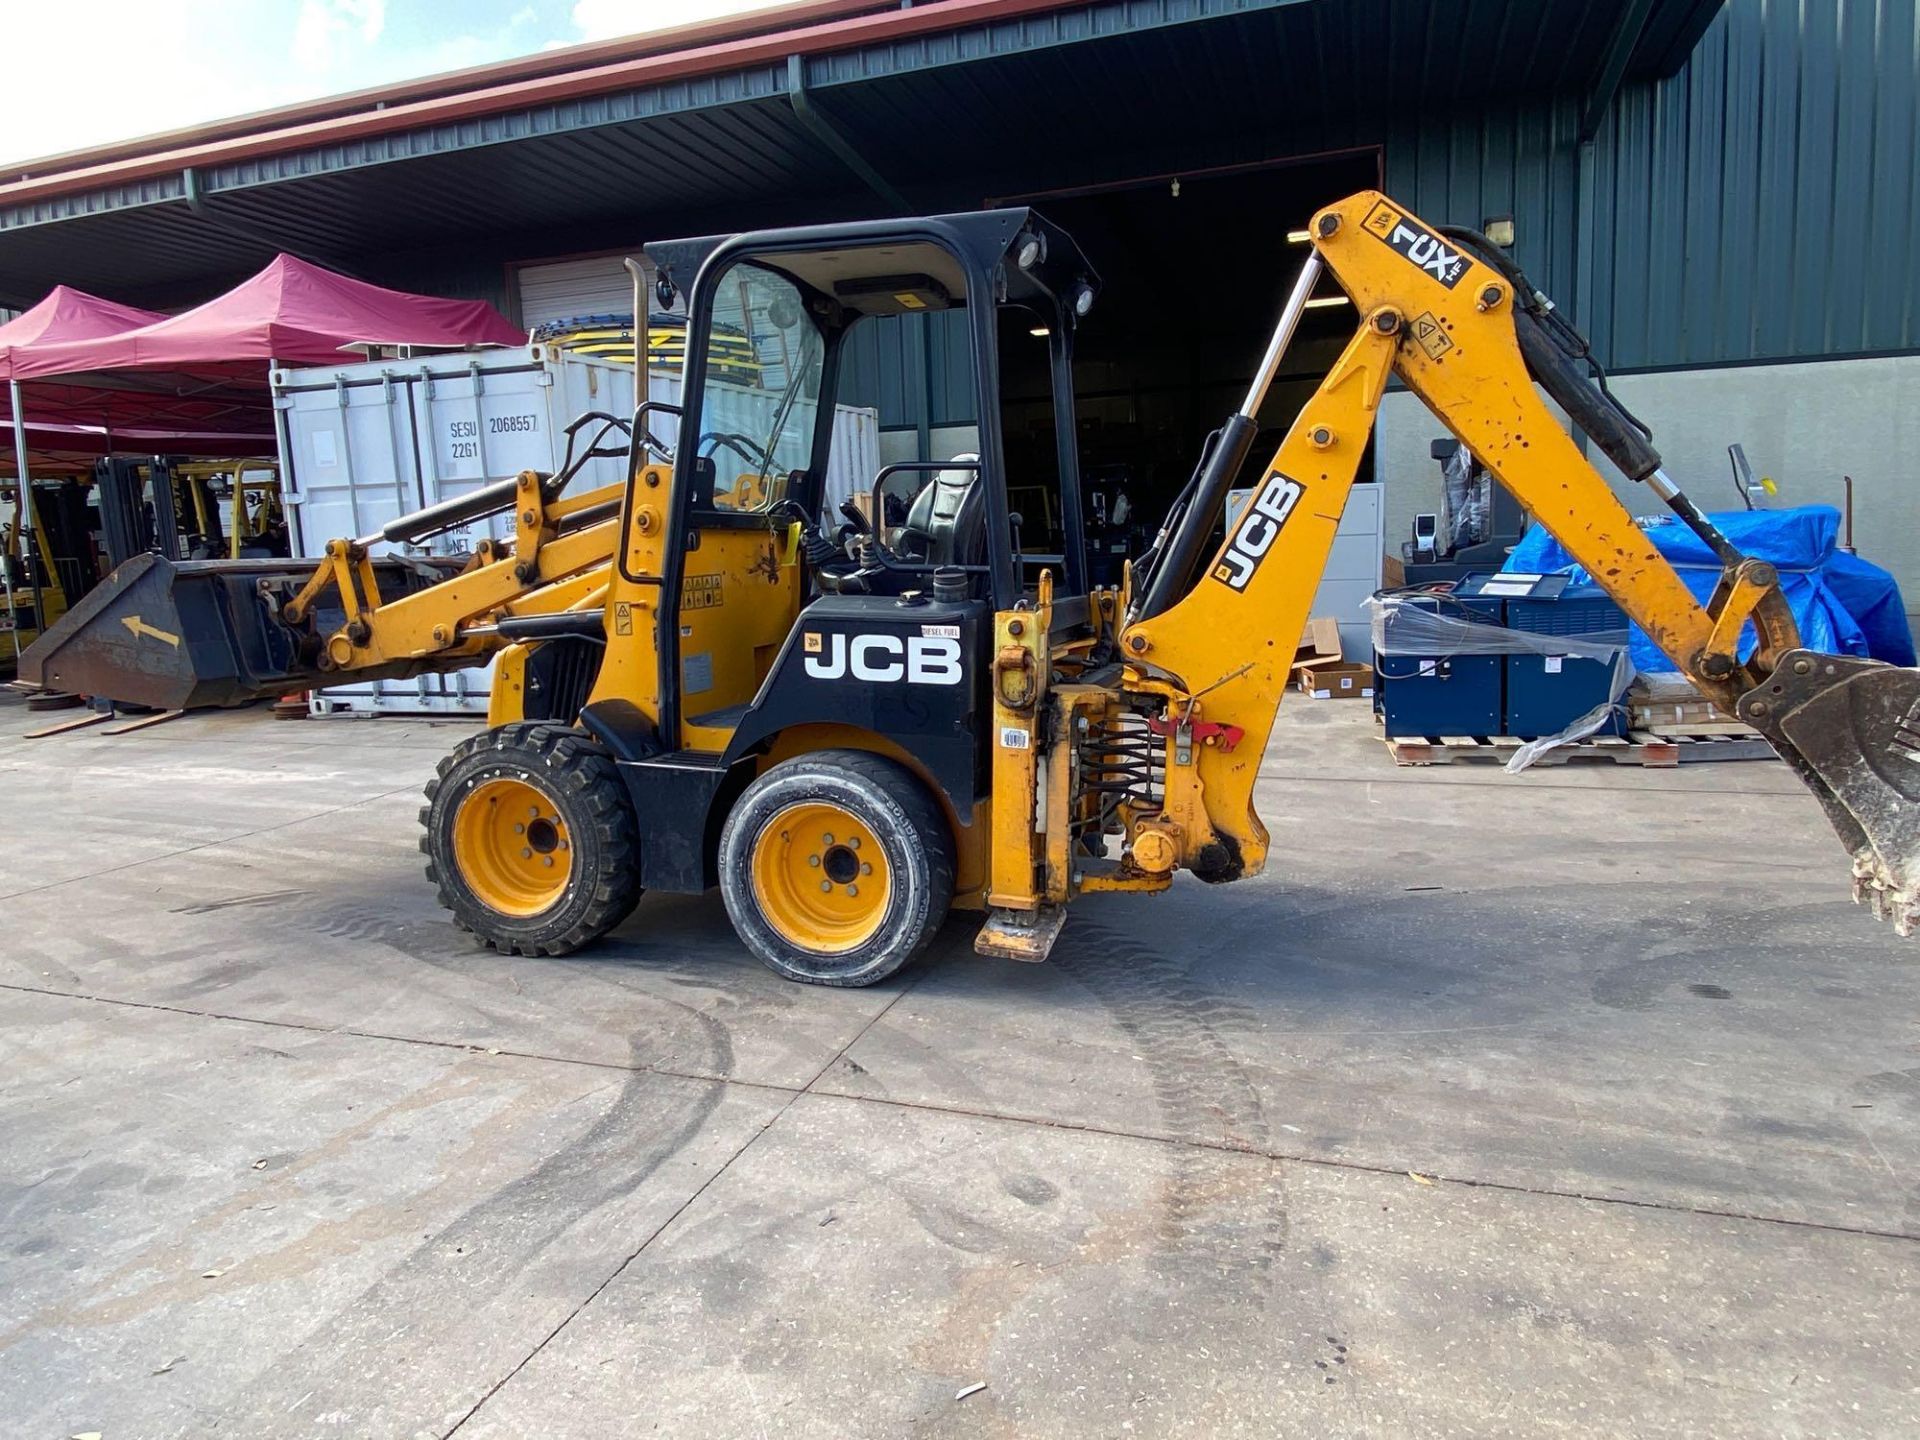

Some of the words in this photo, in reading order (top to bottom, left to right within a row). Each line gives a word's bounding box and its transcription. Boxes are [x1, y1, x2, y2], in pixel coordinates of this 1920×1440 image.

[1393, 224, 1462, 281] 1CX
[1445, 261, 1462, 281] HF
[450, 421, 477, 438] SESU
[490, 415, 537, 433] 2068557
[452, 442, 478, 458] 22G1
[1225, 476, 1301, 588] JCB
[922, 628, 942, 636] DIESEL
[944, 628, 958, 637] FUEL
[804, 633, 963, 685] JCB
[886, 801, 923, 861] SOLIDEAL
